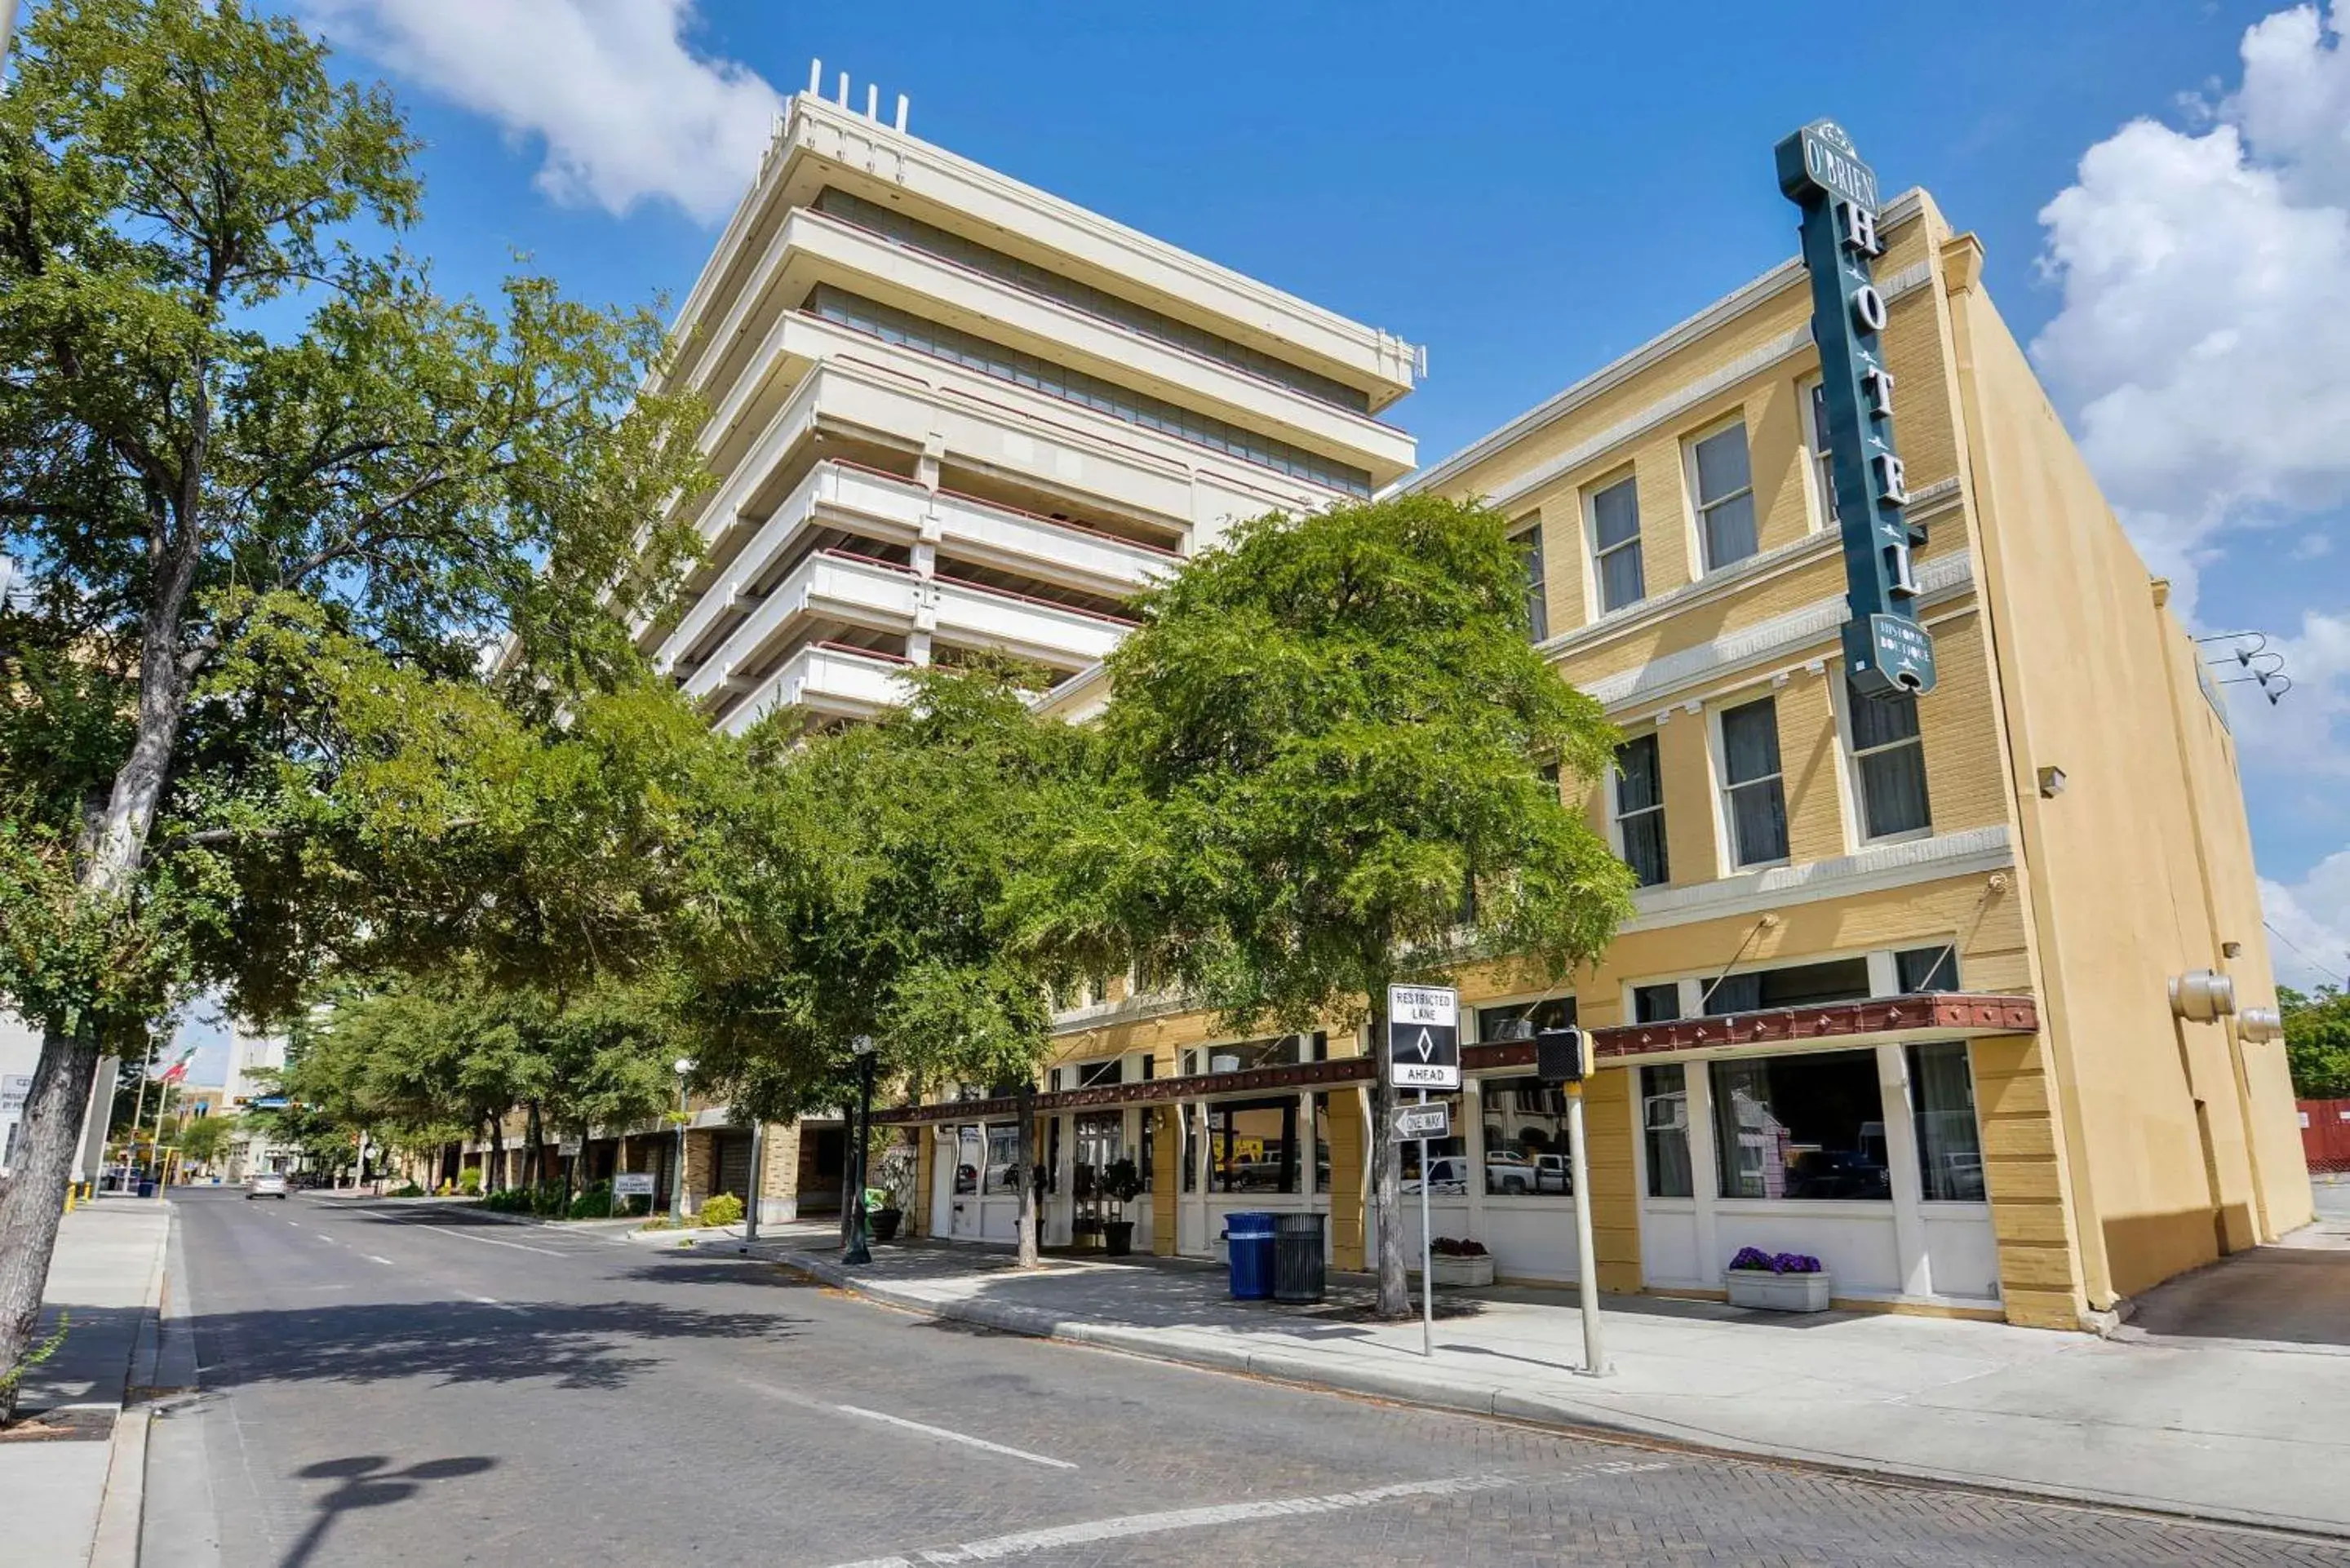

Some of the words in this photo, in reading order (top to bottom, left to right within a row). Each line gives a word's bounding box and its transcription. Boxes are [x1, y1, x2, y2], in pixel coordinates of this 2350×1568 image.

[1807, 138, 1877, 210] O'BRIEN
[1841, 201, 1922, 599] HOTEL
[1396, 992, 1451, 1007] RESTRICTED
[1412, 1008, 1436, 1021] LANE
[1408, 1069, 1444, 1082] AHEAD
[1407, 1115, 1422, 1129] ONE
[1425, 1113, 1442, 1127] WAY
